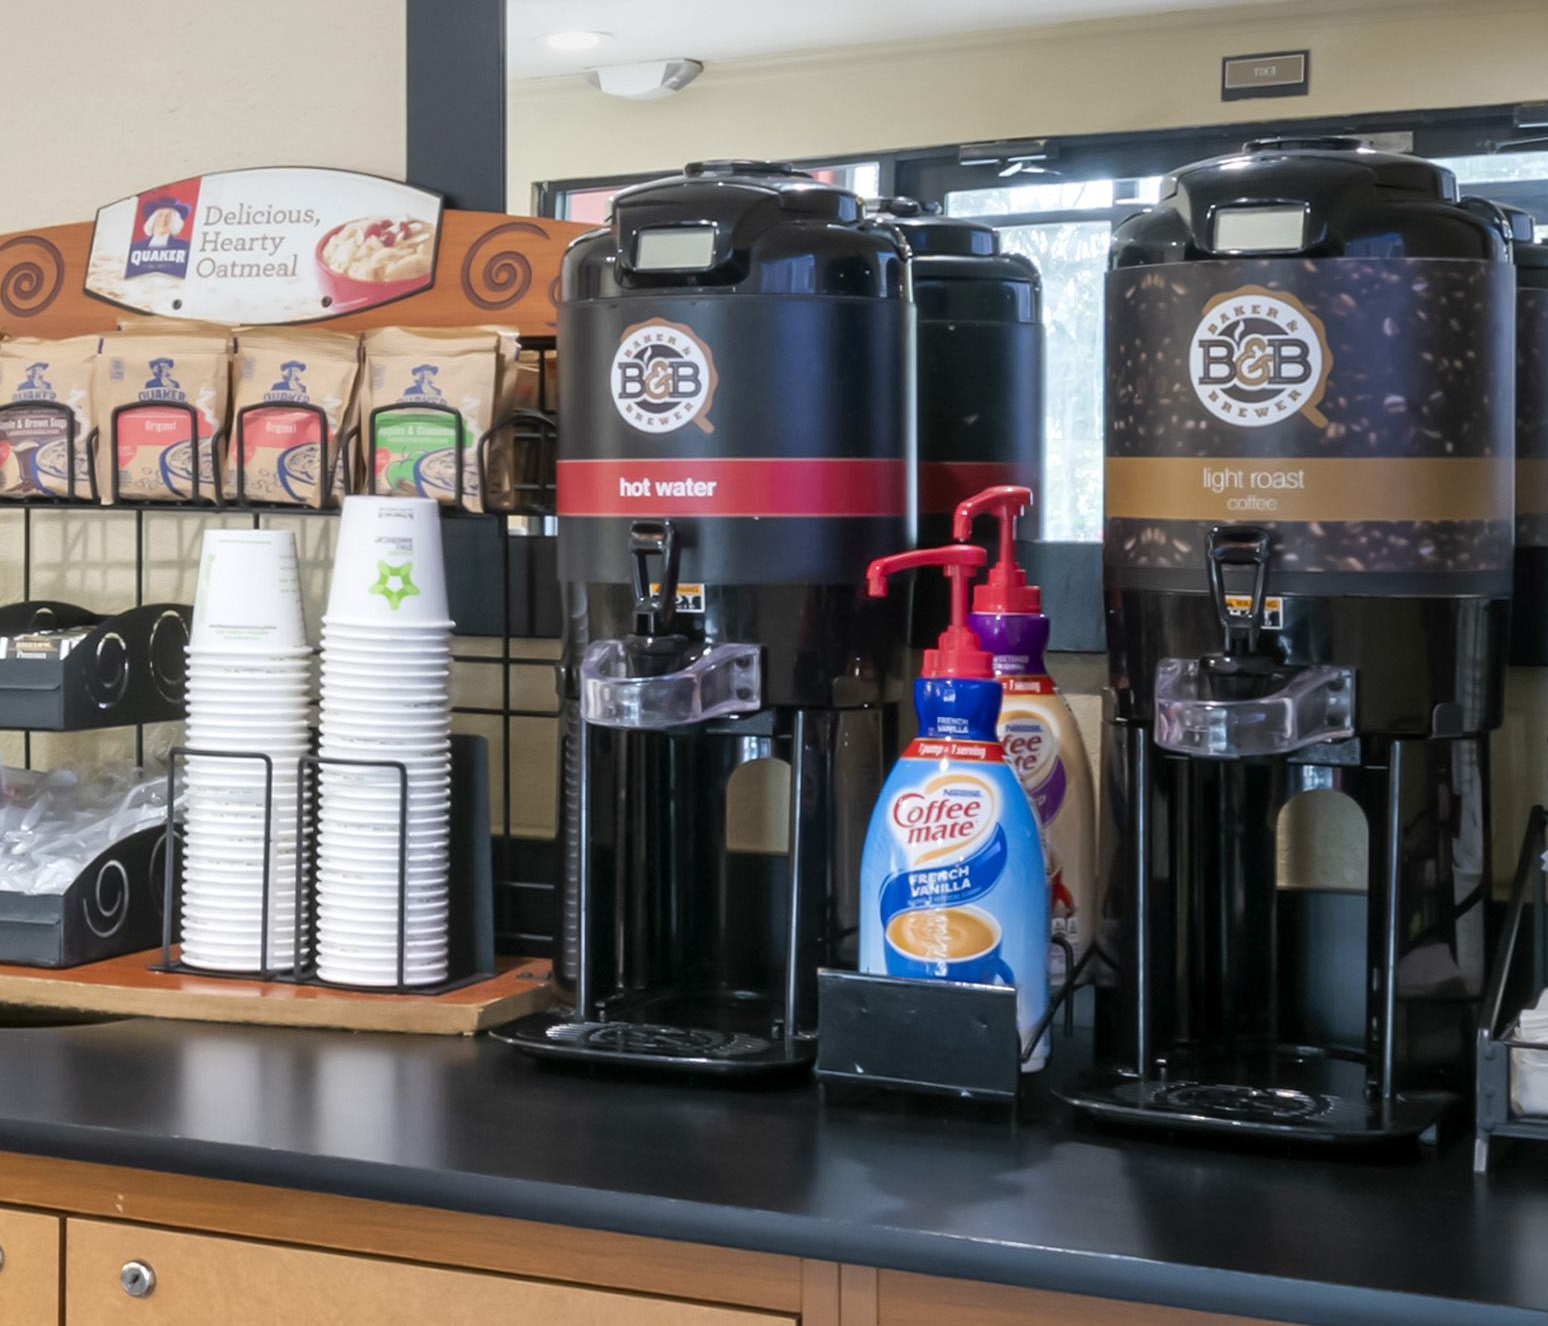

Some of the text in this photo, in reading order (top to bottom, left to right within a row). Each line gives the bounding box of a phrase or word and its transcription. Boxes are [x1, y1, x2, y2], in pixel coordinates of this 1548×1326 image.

[204, 204, 321, 227] Delicious,
[199, 231, 286, 256] Hearty
[131, 249, 187, 266] QUAKER
[196, 254, 299, 279] Oatmeal
[1207, 304, 1279, 335] BAKER
[623, 333, 677, 359] BAKER
[1198, 337, 1312, 387] B&B
[617, 360, 702, 400] B&B
[625, 401, 695, 426] BREWER
[1207, 389, 1303, 419] BREWER
[145, 421, 176, 432] Original
[265, 422, 297, 434] Original
[619, 477, 717, 497] hot water
[1202, 467, 1305, 493] light roast
[1226, 495, 1278, 511] coffee
[1001, 733, 1042, 756] fee
[892, 792, 981, 829] Coffee
[907, 820, 975, 845] mate
[909, 866, 970, 886] FRENCH
[910, 878, 972, 897] VANILLA
